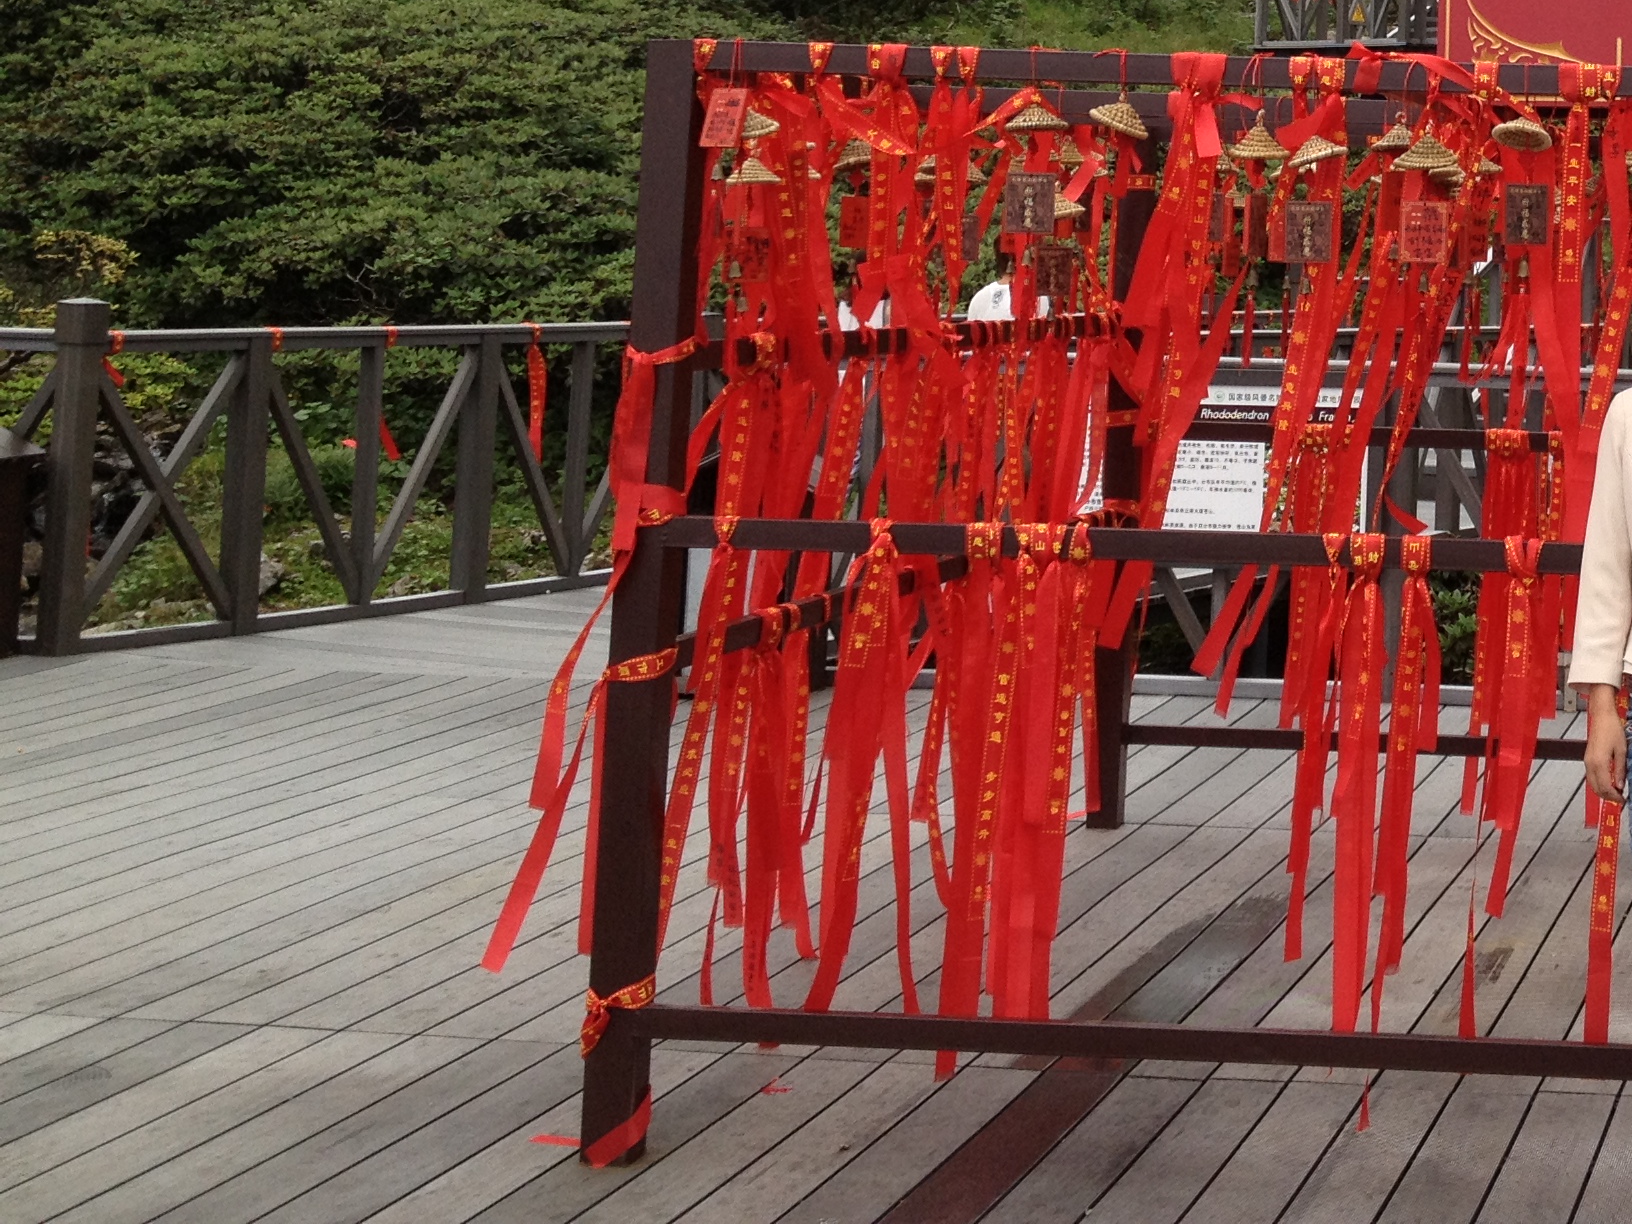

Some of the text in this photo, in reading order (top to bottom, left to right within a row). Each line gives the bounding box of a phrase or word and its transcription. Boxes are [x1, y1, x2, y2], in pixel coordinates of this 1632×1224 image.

[1565, 142, 1581, 206] 一生平安
[1201, 408, 1269, 421] Rhododendron
